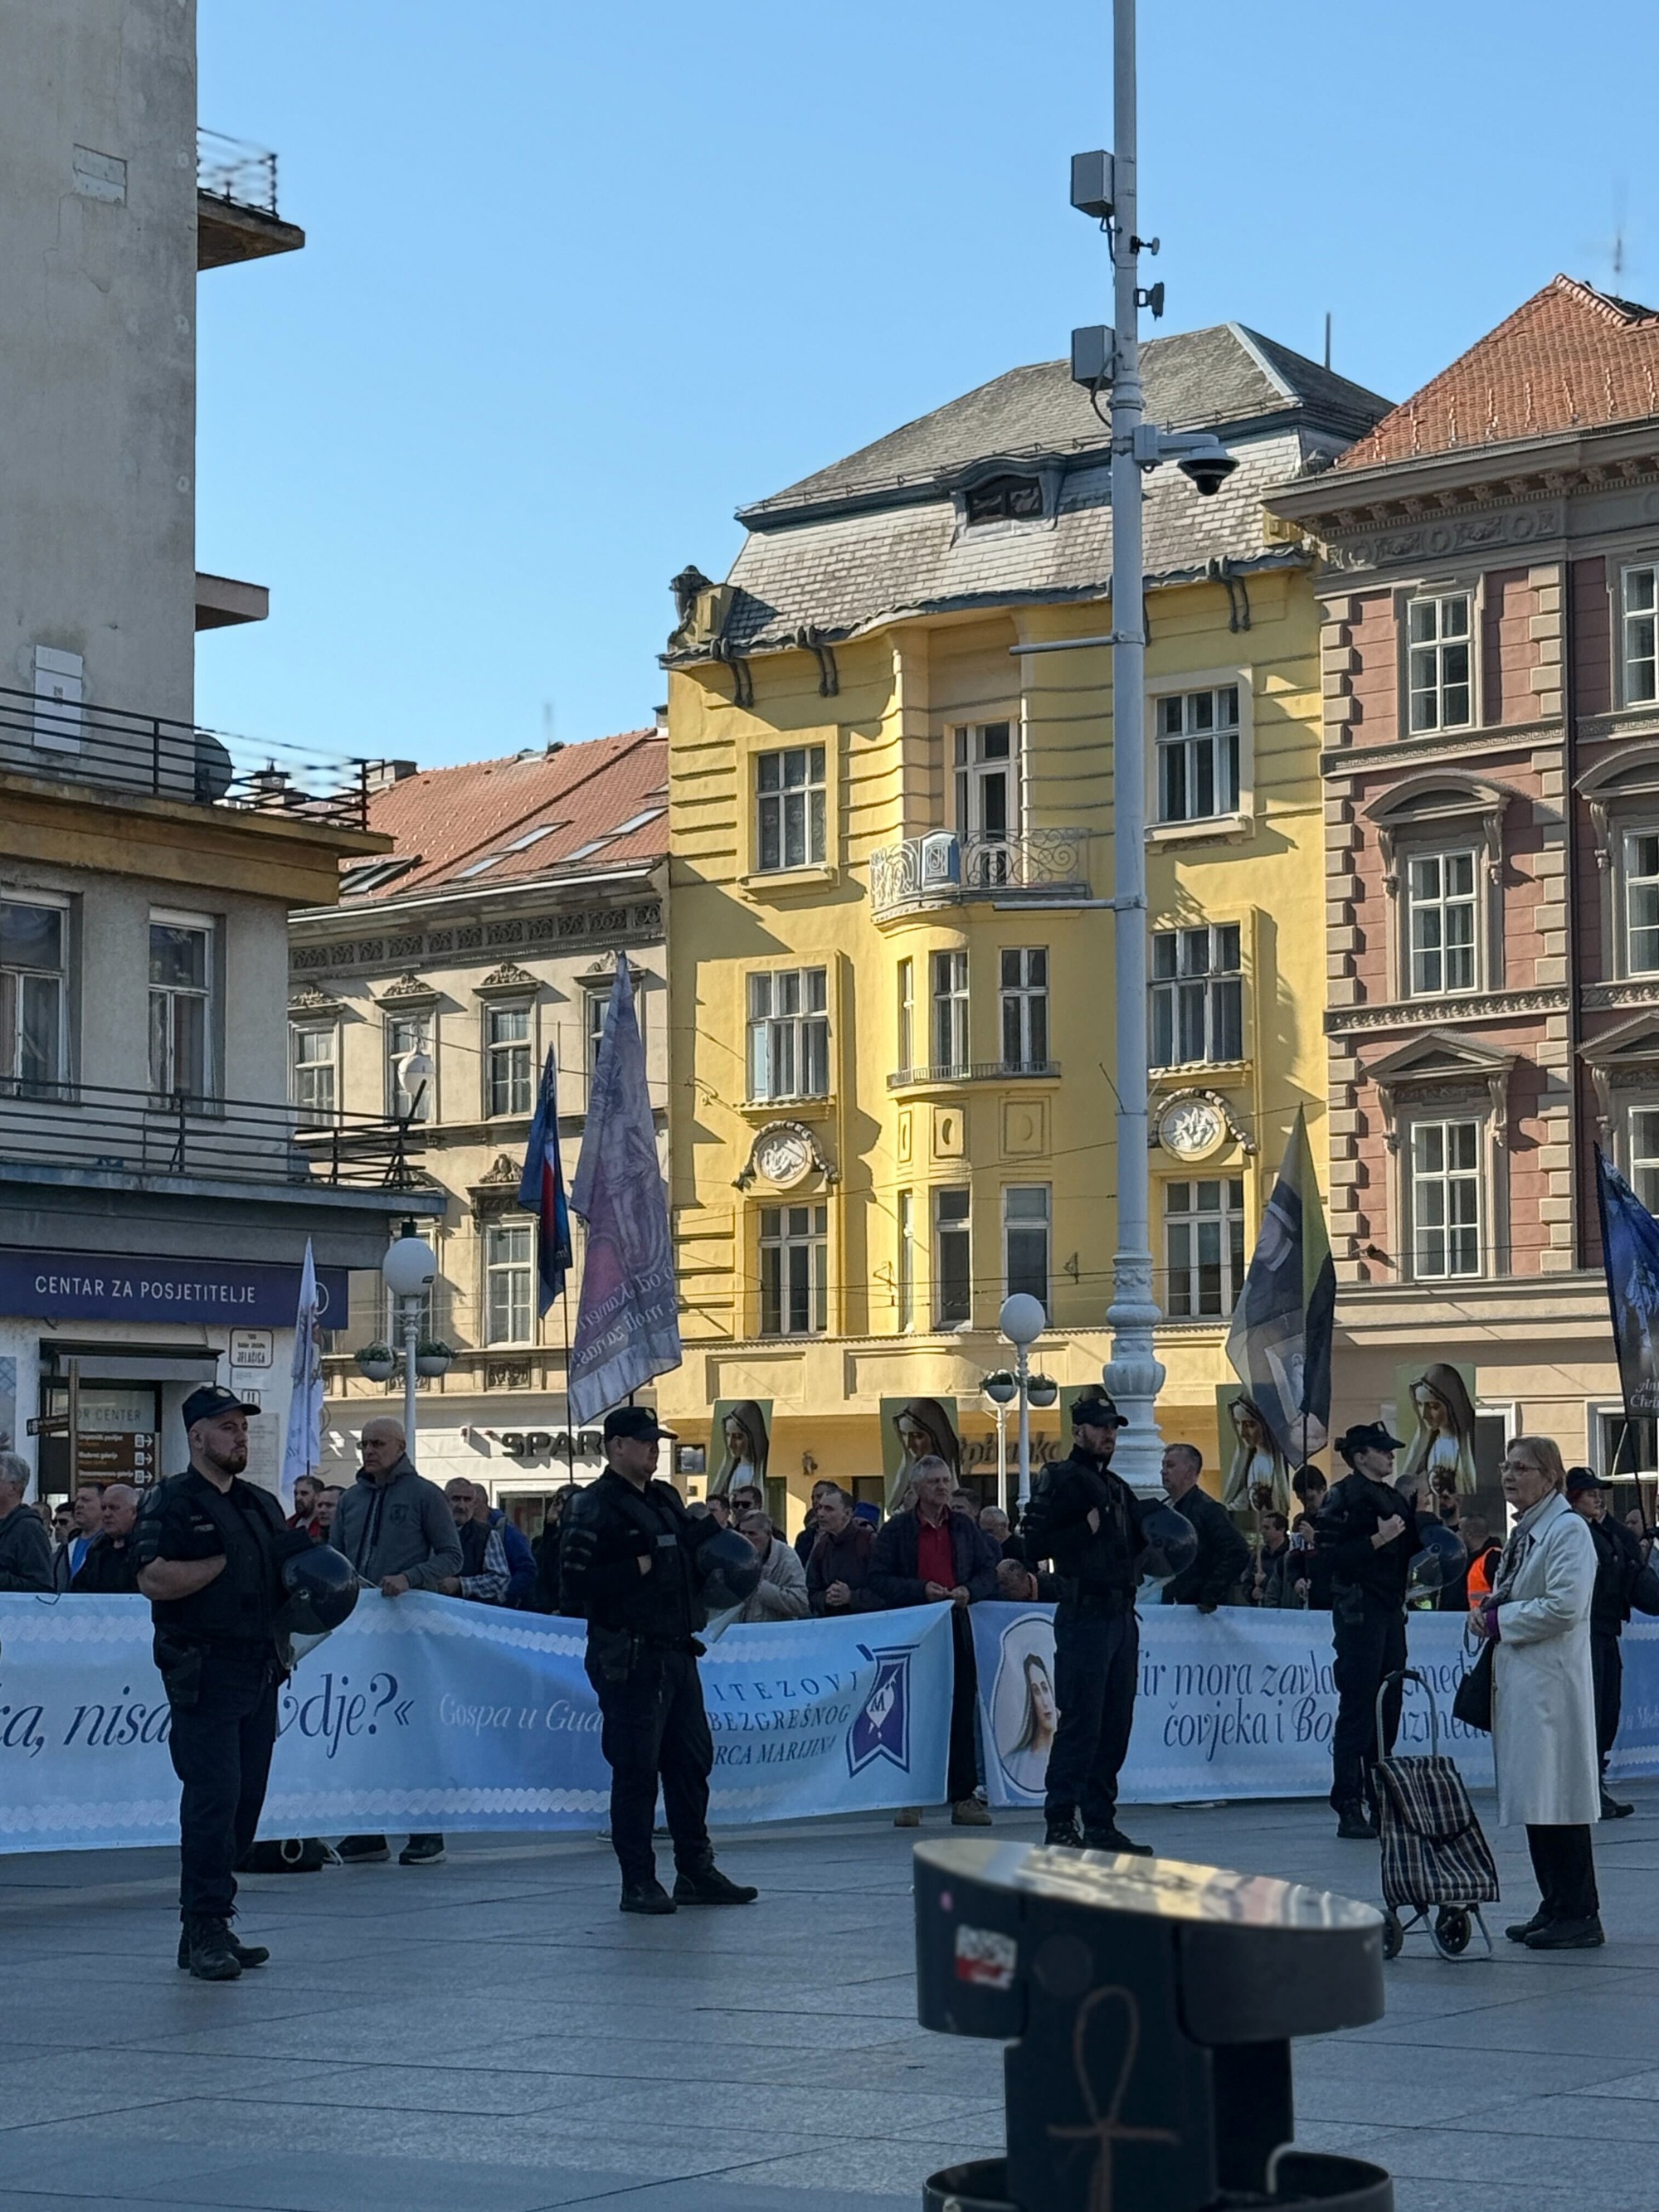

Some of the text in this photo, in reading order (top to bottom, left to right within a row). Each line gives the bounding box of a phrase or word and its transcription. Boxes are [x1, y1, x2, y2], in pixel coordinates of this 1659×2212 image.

[35, 1275, 255, 1303] CENTAR ZA POSJETITELJE
[95, 1408, 141, 1422] CENTER
[501, 1431, 605, 1457] SPAR
[711, 1670, 858, 1702] ITEZOVI
[1136, 1650, 1166, 1697] ir
[1173, 1662, 1253, 1697] mora
[1259, 1649, 1338, 1698] zavla
[0, 1672, 414, 1760] a, nisa vdje?«
[440, 1693, 602, 1738] Gospa u Gua
[1163, 1697, 1271, 1762] čovjeka
[1274, 1698, 1287, 1744] i
[1290, 1690, 1335, 1757] Bo
[714, 1743, 752, 1766] RCA
